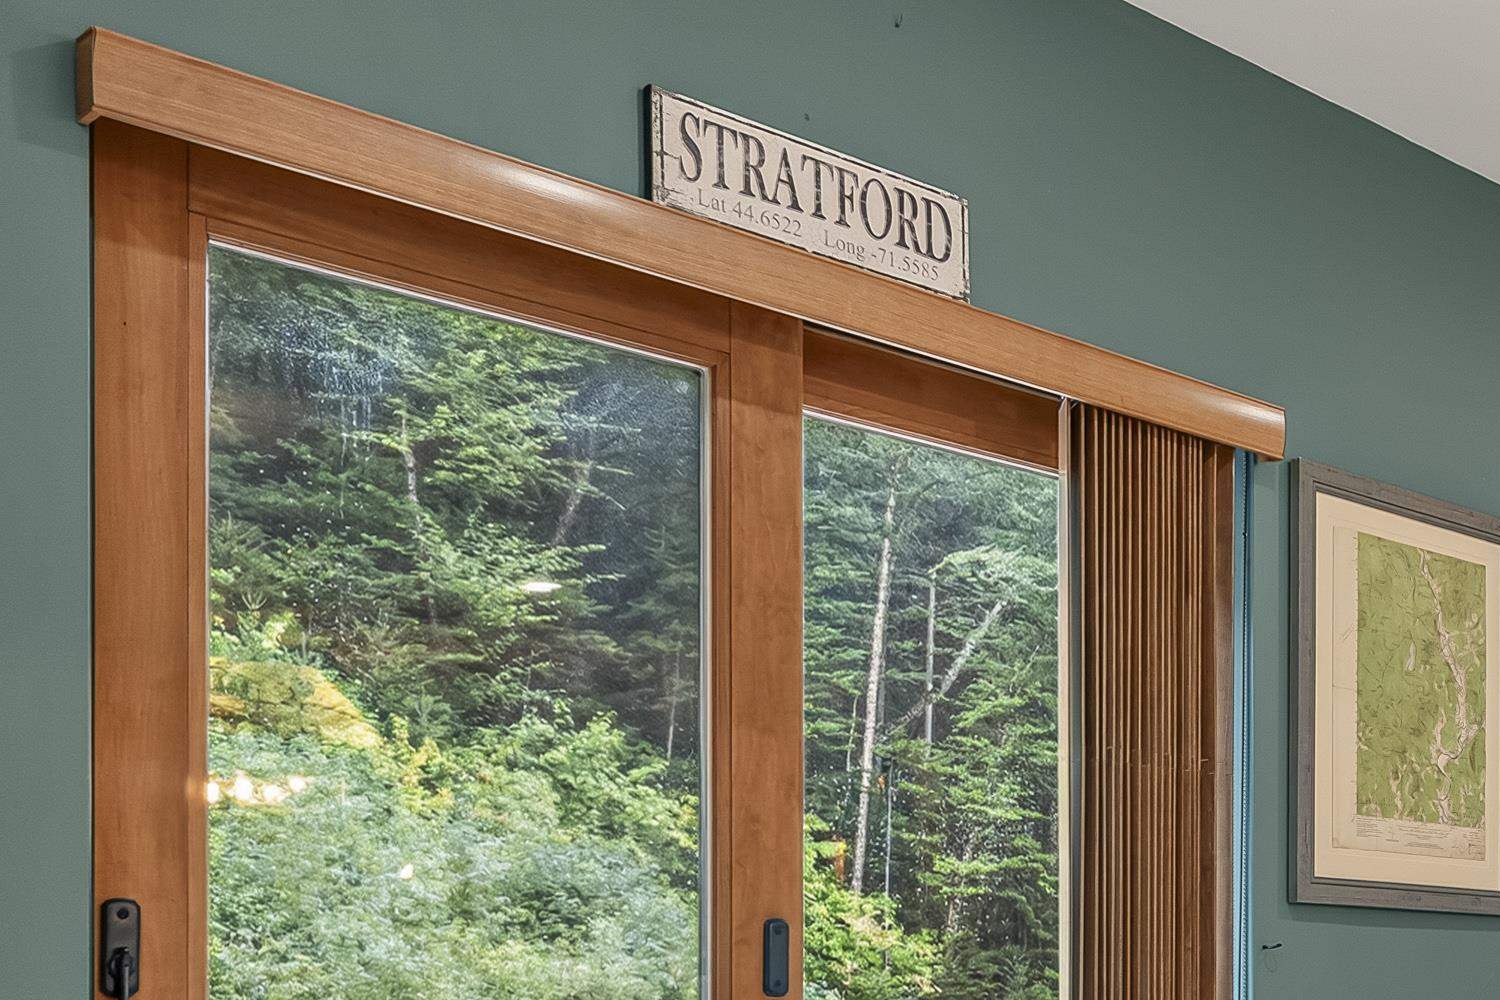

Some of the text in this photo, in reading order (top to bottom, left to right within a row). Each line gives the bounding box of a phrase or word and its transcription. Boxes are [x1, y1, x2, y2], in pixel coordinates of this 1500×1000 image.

[679, 111, 953, 264] STRATFORD
[697, 187, 940, 282] Lat 44.6522 Long -71.5585
